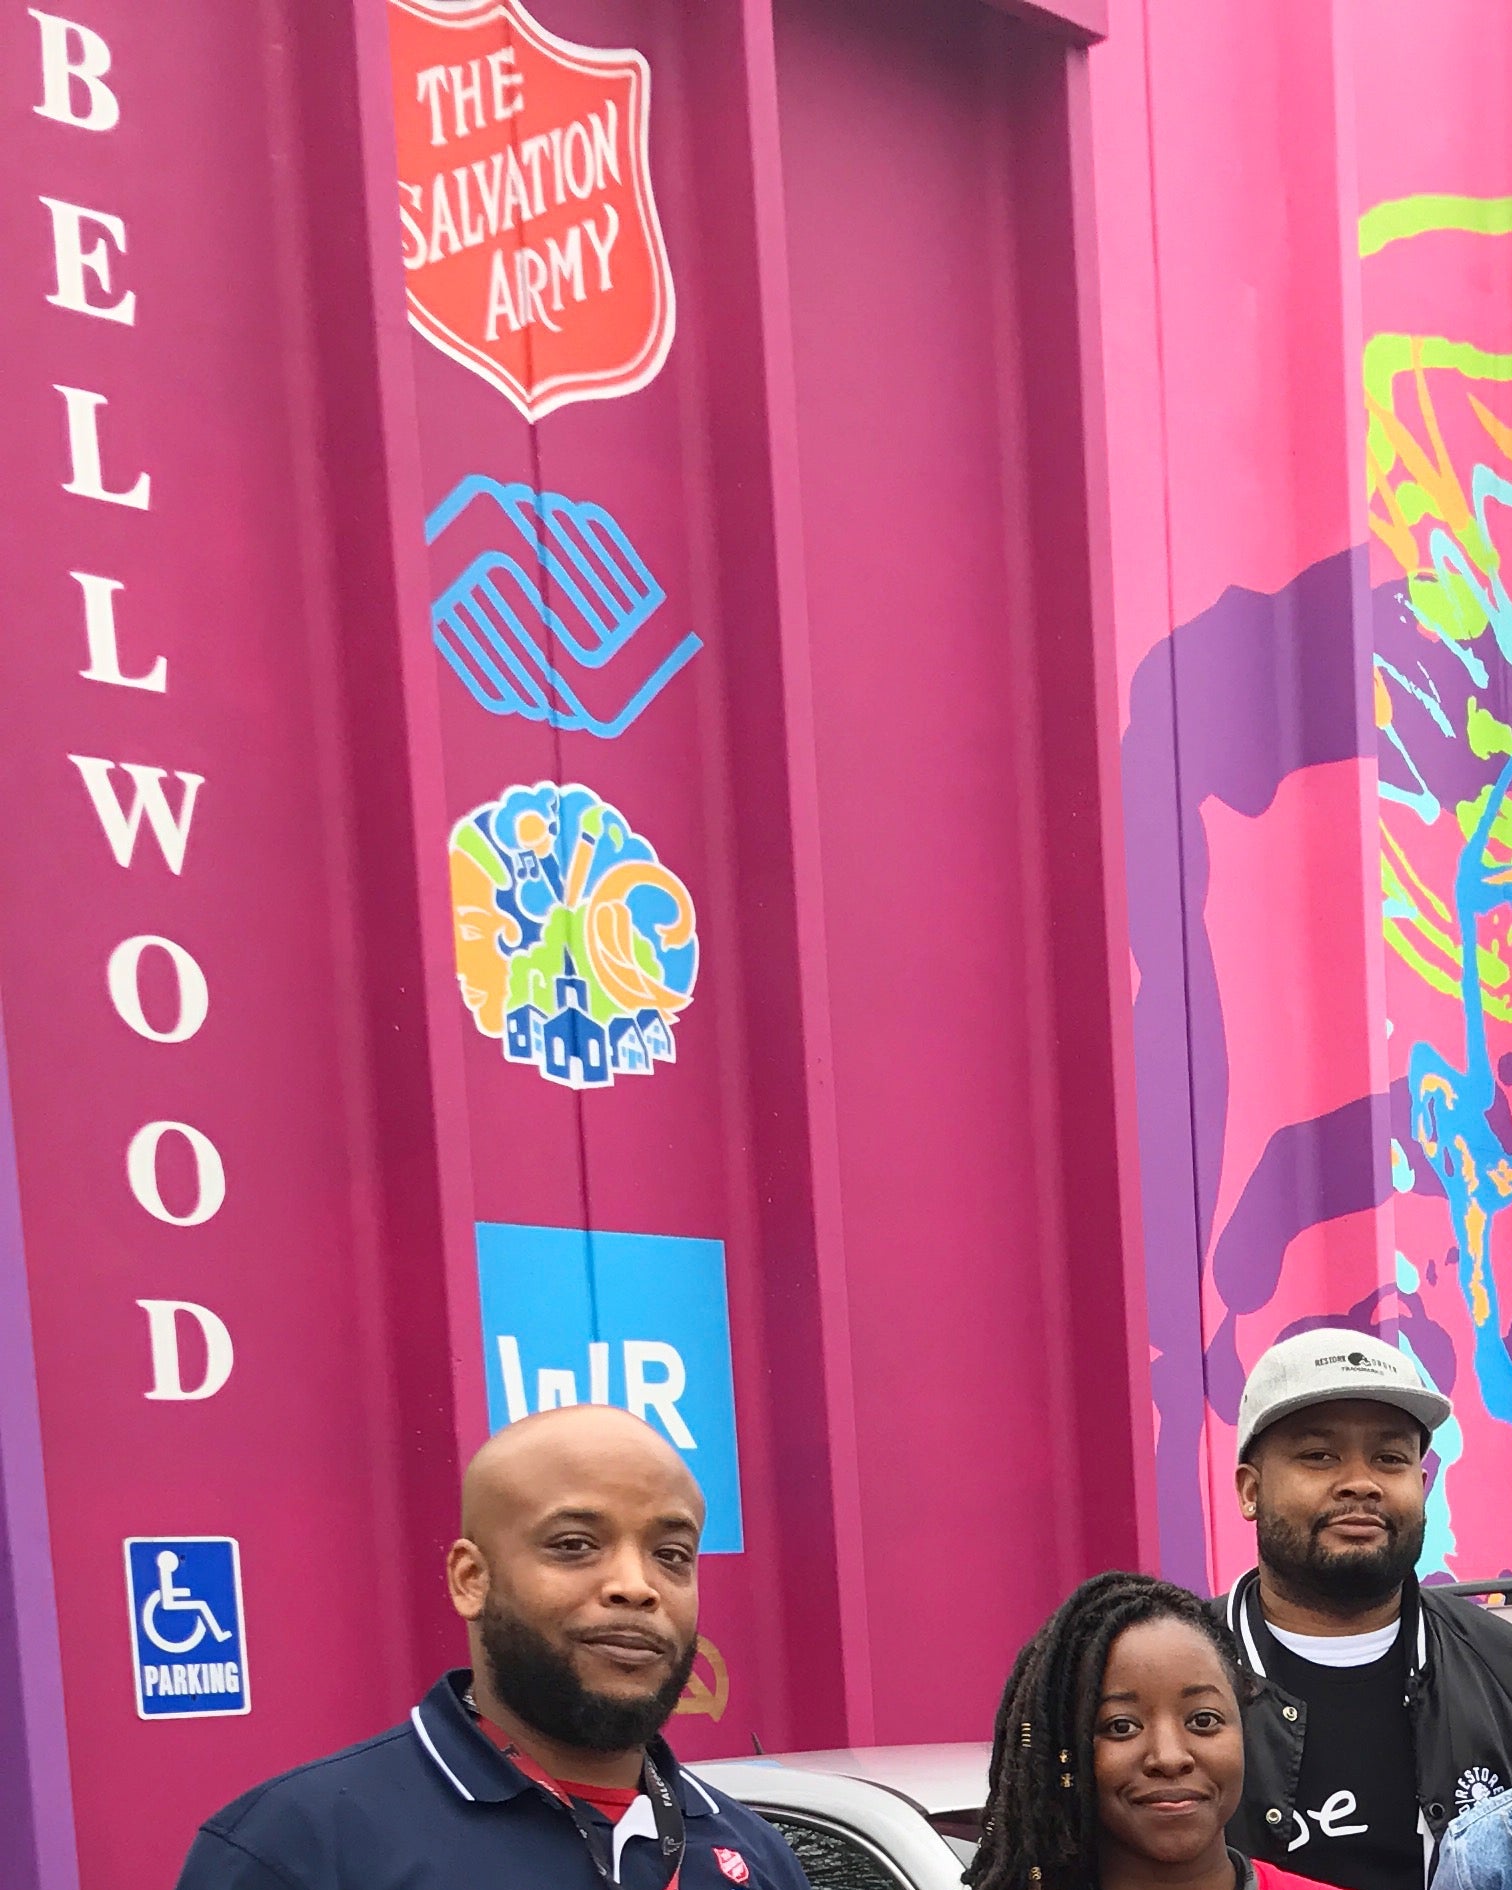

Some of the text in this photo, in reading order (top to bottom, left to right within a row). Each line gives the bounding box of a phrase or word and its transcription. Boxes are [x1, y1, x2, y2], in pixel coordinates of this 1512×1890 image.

[417, 46, 524, 147] THE
[399, 99, 623, 271] SALVATION
[485, 203, 620, 342] ARMY
[144, 1661, 240, 1697] PARKING
[1454, 1766, 1505, 1799] RESTORE
